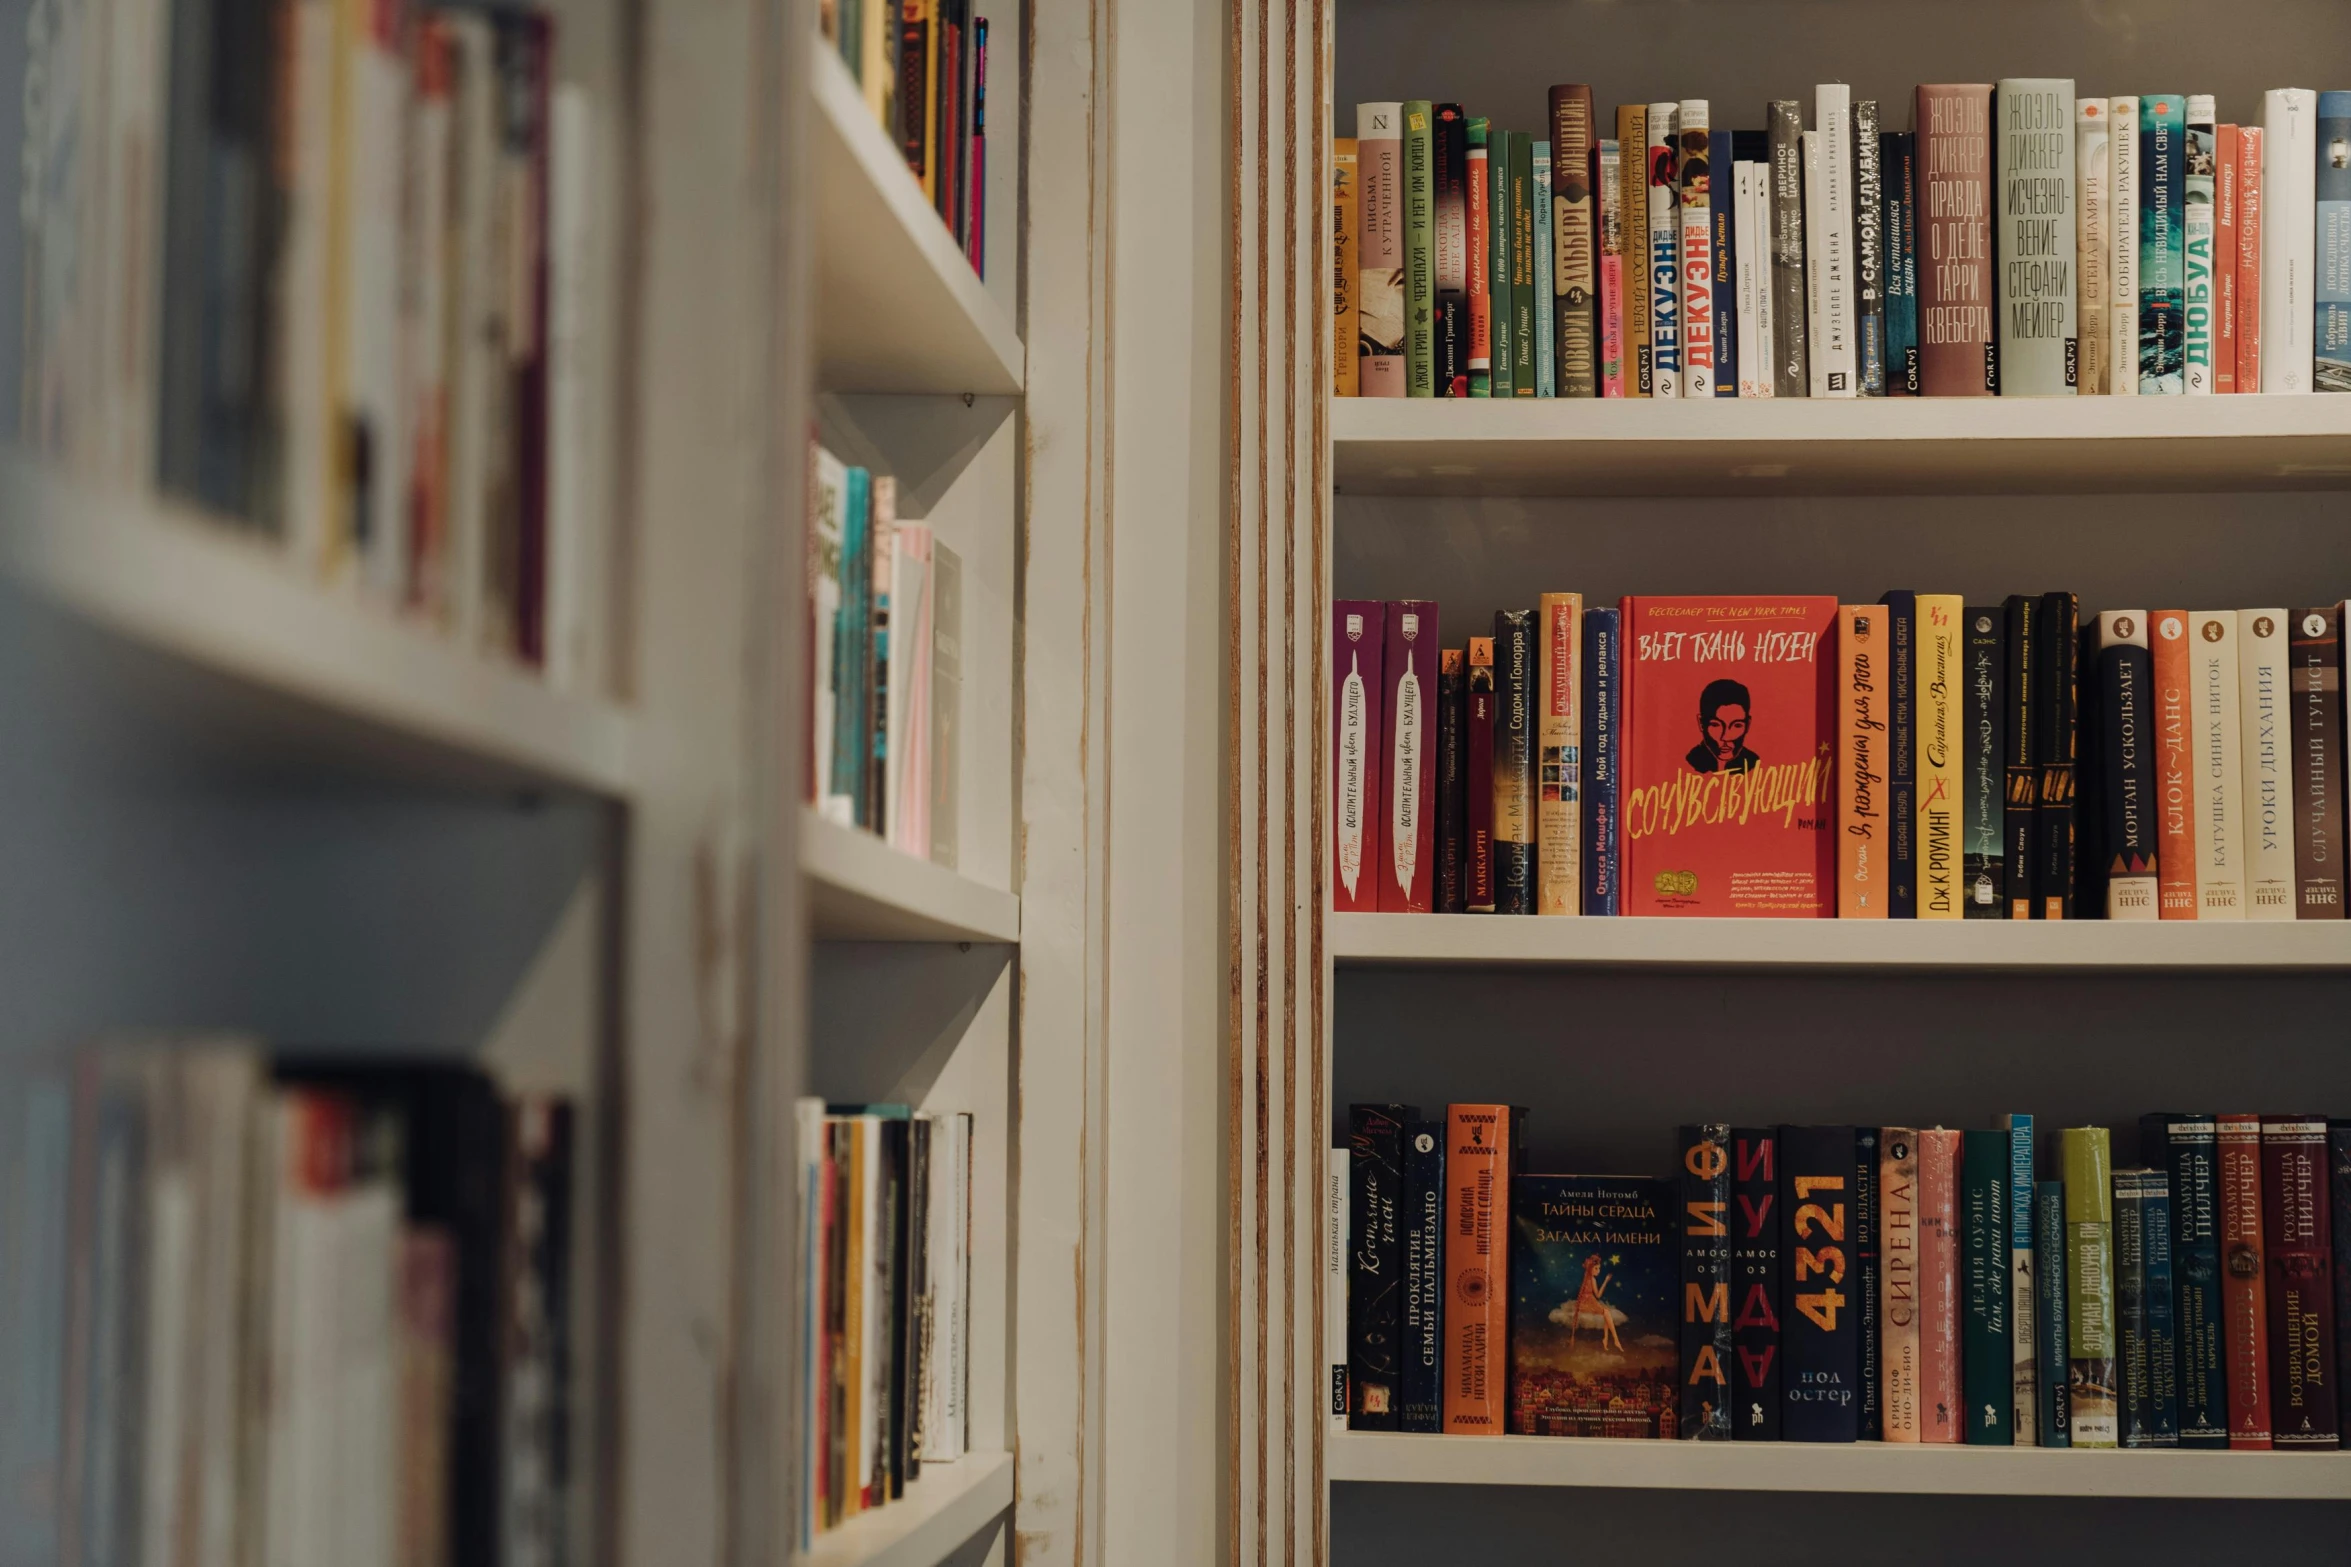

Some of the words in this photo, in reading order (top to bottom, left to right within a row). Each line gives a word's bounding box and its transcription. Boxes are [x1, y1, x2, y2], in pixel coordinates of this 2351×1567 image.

[1929, 97, 1984, 134] ЖОЭЛЬ
[2009, 94, 2063, 130] ЖОЭЛЬ
[1411, 137, 1425, 171] КОНЦА
[1556, 99, 1587, 176] ЭЙНШТЕЙН
[2008, 133, 2064, 177] ДИККЕР
[2118, 123, 2129, 192] РАКУШЕК
[2156, 121, 2167, 151] СВЕТ
[1778, 143, 1787, 198] ЗВЕРИНОЕ
[1788, 149, 1798, 197] ЦАРСТВО
[1860, 119, 1874, 206] ГЛУБИНЕ
[1929, 137, 1985, 180] ДИККЕР
[2157, 155, 2167, 181] НАМ
[1368, 175, 1377, 232] ПИСЬМА
[1380, 152, 1391, 243] УТРАЧЕННОЙ
[1412, 176, 1425, 190] ИМ
[1931, 181, 1983, 222] ПРАВДА
[2009, 178, 2070, 215] ИСЧЕЗНО-
[1413, 197, 1425, 217] НЕТ
[1413, 221, 1425, 229] И
[2086, 177, 2098, 242] ПАМЯТИ
[2153, 186, 2167, 263] НЕВИДИМЫЙ
[1382, 247, 1392, 255] К
[1562, 207, 1588, 284] АЛЬБЕРТ
[1653, 230, 1677, 242] ДИДЬЕ
[1685, 226, 1709, 238] ДИДЬЕ
[1717, 213, 1726, 247] Тьеполо
[1780, 210, 1789, 262] Жан-Батист
[1858, 212, 1875, 282] САМОЙ
[1889, 200, 1901, 271] оставшаяся
[1932, 223, 1940, 260] О
[1947, 223, 1984, 262] ДЕЛЕ
[2017, 220, 2058, 256] ВЕНИЕ
[2118, 198, 2129, 297] СОБИРАТЕЛЬ
[1414, 247, 1426, 301] ЧЕРЕПАХИ
[1717, 250, 1727, 282] Пузырь
[1830, 232, 1841, 280] ДЖЕННА
[1903, 258, 1914, 296] жизнь
[2087, 249, 2098, 298] СТЕНА
[1864, 290, 1875, 300] В
[1889, 275, 1901, 295] Вся
[1937, 264, 1980, 301] ГАРРИ
[2009, 261, 2067, 298] СТЕФАНИ
[2156, 269, 2167, 297] ВЕСЬ
[1444, 302, 1455, 342] Гринберг
[1654, 242, 1680, 372] ДЕКУЭН
[1686, 239, 1712, 369] ДЕКУЭН
[1831, 288, 1843, 350] ДЖУЗЕППЕ
[2013, 298, 2064, 338] МЕЙЛЕР
[2187, 237, 2209, 367] ДЮБУА
[1415, 329, 1427, 356] ГРИН
[1564, 310, 1590, 378] ГОВОРИТ
[1926, 306, 1991, 343] КВЕБЕРТА
[2119, 313, 2130, 337] Дорр
[1415, 361, 1430, 389] ДЖОН
[1445, 344, 1455, 378] Джоанн
[2119, 339, 2128, 373] Энтони
[1649, 607, 1703, 616] БЕСТСЕЛЛЕР
[1707, 607, 1726, 616] THE
[1730, 607, 1751, 616] NEW
[1755, 607, 1777, 616] YORK
[1780, 607, 1807, 615] TIMES
[1511, 632, 1525, 679] Гоморра
[1597, 632, 1608, 676] релакса
[1639, 632, 1687, 662] ВЬЕТ
[1690, 631, 1745, 662] ТХАНЬ
[1754, 631, 1816, 663] НГУЕН
[1931, 636, 1952, 698] Вакансия
[1513, 682, 1522, 690] и
[1853, 654, 1873, 692] этого
[2209, 658, 2221, 714] НИТОК
[2308, 656, 2323, 730] ТУРИСТ
[1348, 682, 1360, 726] БУДУЩЕГО
[1402, 681, 1414, 726] БУДУЩЕГО
[1511, 693, 1524, 729] Содом
[1597, 691, 1608, 731] отдыха
[1853, 696, 1885, 730] для
[2120, 659, 2136, 769] УСКОЛЬЗАЕТ
[2259, 666, 2277, 772] ДЫХАНИЯ
[1347, 732, 1359, 755] цвет
[1401, 732, 1413, 755] цвет
[1597, 735, 1608, 753] год
[1927, 701, 1948, 768] Случайная
[2211, 721, 2224, 778] СИНИХ
[1595, 757, 1606, 780] Мой
[1853, 735, 1882, 819] рожден(а)
[1346, 758, 1357, 828] ОСЛЕПИТЕЛЬНЫЙ
[1400, 758, 1411, 827] ОСЛЕПИТЕЛЬНЫЙ
[2124, 779, 2138, 847] МОРГАН
[2308, 738, 2326, 862] СЛУЧАЙНЫЙ
[1596, 803, 1608, 851] Мошфег
[1848, 823, 1873, 840] Я
[2212, 784, 2226, 866] КАТУШКА
[2261, 780, 2277, 850] УРОКИ
[1476, 830, 1487, 896] МАККАРТИ
[1596, 856, 1607, 895] Отесса
[2164, 899, 2193, 908] ЭНН
[2306, 894, 2337, 904] ЭНН
[2013, 1126, 2031, 1187] ИМПЕРАТОРА
[1331, 1176, 1341, 1214] страна
[1542, 1202, 1594, 1217] ТАЙНЫ
[1599, 1205, 1655, 1219] СЕРДЦА
[1560, 1189, 1593, 1199] Амели
[1597, 1190, 1638, 1199] Нотомб
[1857, 1164, 1868, 1219] ВЛАСТИ
[1991, 1179, 2001, 1221] поют
[2013, 1190, 2030, 1233] ПОИСКАХ
[2180, 1152, 2194, 1241] РОЗАМУНДА
[2196, 1155, 2212, 1236] ПИЛЧЕР
[2226, 1151, 2240, 1241] РОЗАМУНДА
[2240, 1154, 2256, 1236] ПИЛЧЕР
[2282, 1152, 2296, 1241] РОЗАМУНДА
[2297, 1155, 2313, 1237] ПИЛЧЕР
[1357, 1170, 1379, 1274] Костяные
[1381, 1198, 1394, 1243] часы
[1536, 1229, 1601, 1244] ЗАГАДКА
[1606, 1232, 1660, 1245] ИМЕНИ
[1858, 1224, 1868, 1243] ВО
[1972, 1188, 1984, 1248] ОУЭНС
[1330, 1216, 1340, 1275] Маленькая
[1424, 1192, 1436, 1303] ПАЛЬМИЗАНО
[1686, 1249, 1728, 1257] АМОС
[1736, 1249, 1776, 1258] АМОС
[1795, 1176, 1845, 1332] 4321
[1889, 1182, 1911, 1327] СИРЕНА
[1989, 1227, 2005, 1269] раки
[1409, 1230, 1421, 1325] ПРОКЛЯТИЕ
[1973, 1256, 1986, 1316] ДЕЛИЯ
[1989, 1271, 2003, 1295] где
[1423, 1309, 1435, 1366] СЕМЬИ
[1988, 1301, 2004, 1334] Там,
[1461, 1325, 1473, 1398] ЧИМАМАНДА
[1475, 1323, 1489, 1363] АДИЧИ
[2287, 1290, 2304, 1407] ВОЗВРАЩЕНИЕ
[2302, 1312, 2322, 1385] ДОМОЙ
[1475, 1366, 1485, 1400] НГОЗИ
[1789, 1389, 1851, 1407] остер
[1802, 1372, 1841, 1383] пол
[1864, 1381, 1875, 1413] Тами
[1891, 1369, 1900, 1429] КРИСТОФ
[1902, 1346, 1912, 1429] ОНО-ДИ-БИО
